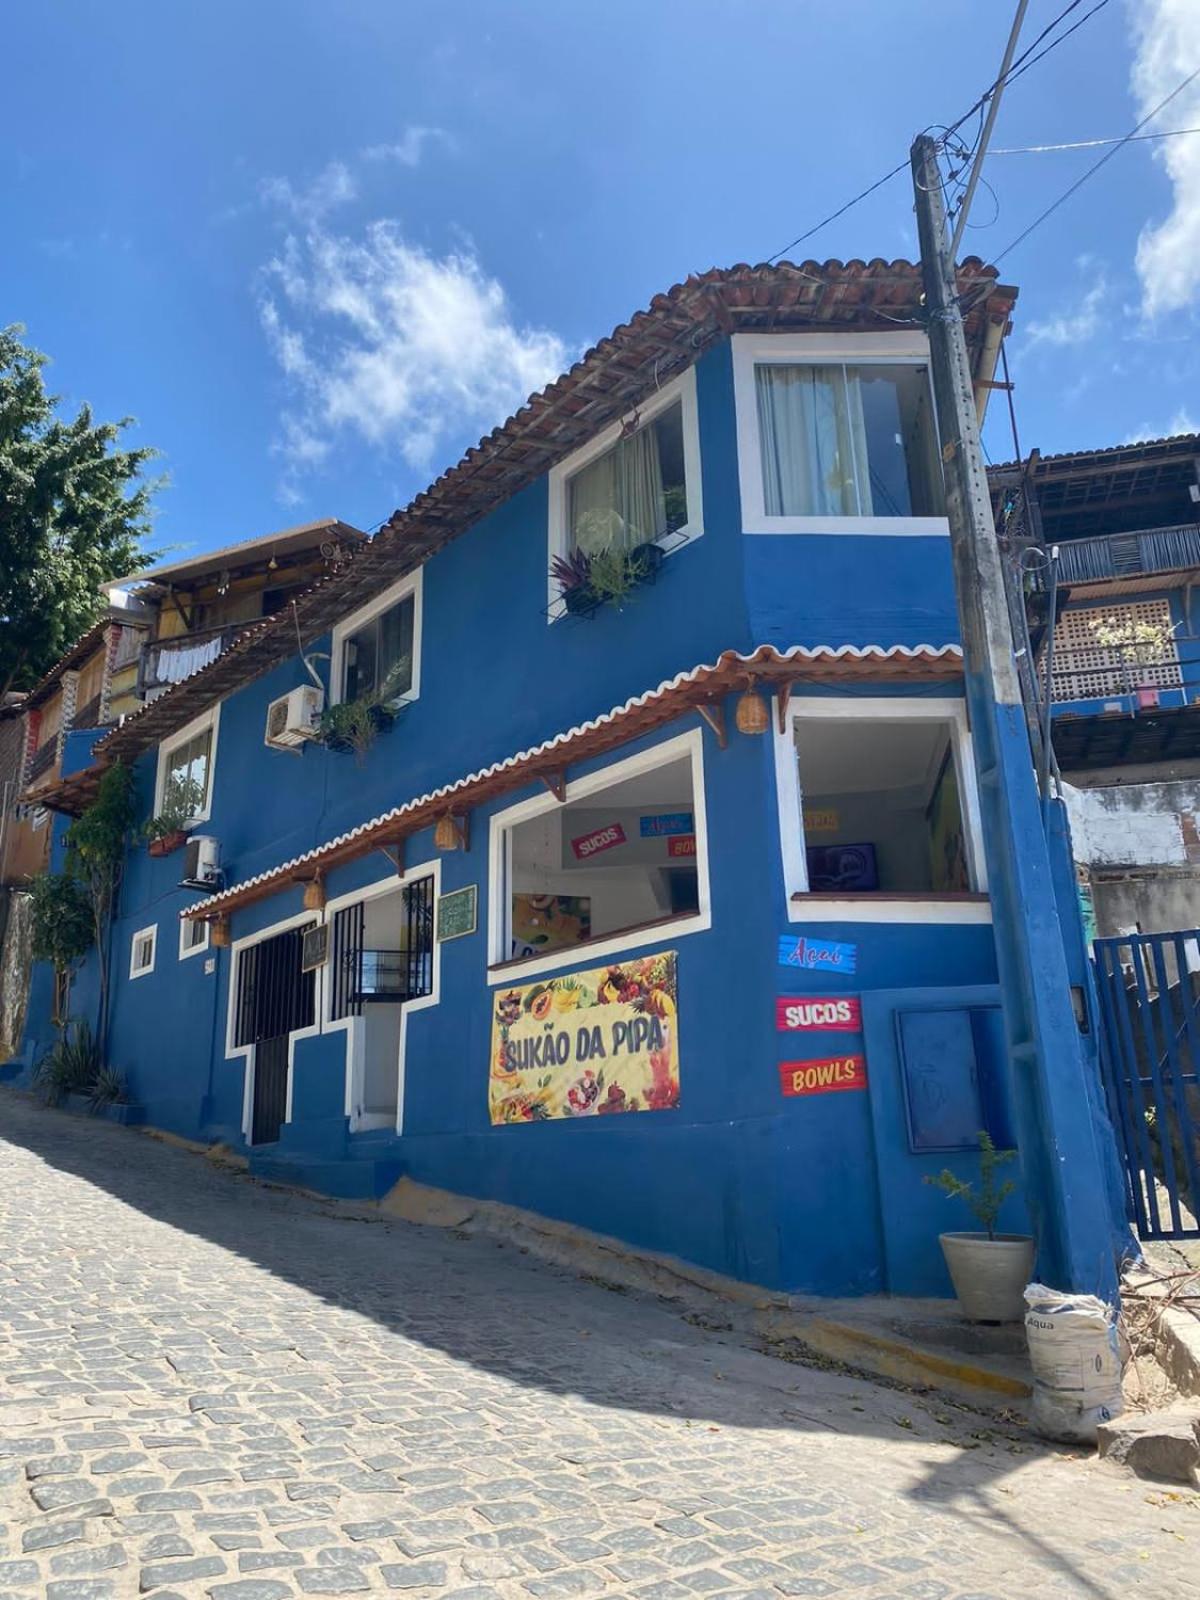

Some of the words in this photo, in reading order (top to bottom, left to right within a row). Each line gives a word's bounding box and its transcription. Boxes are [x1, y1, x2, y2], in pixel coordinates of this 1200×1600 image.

[578, 827, 618, 855] SUCOS
[788, 937, 842, 969] Açaí
[785, 1000, 851, 1028] SUCOS
[504, 1022, 570, 1073] SUKÃO
[575, 1024, 606, 1062] DA
[611, 1015, 664, 1056] PIPA
[791, 1059, 856, 1092] BOWLS
[1027, 1317, 1054, 1330] Aqua
